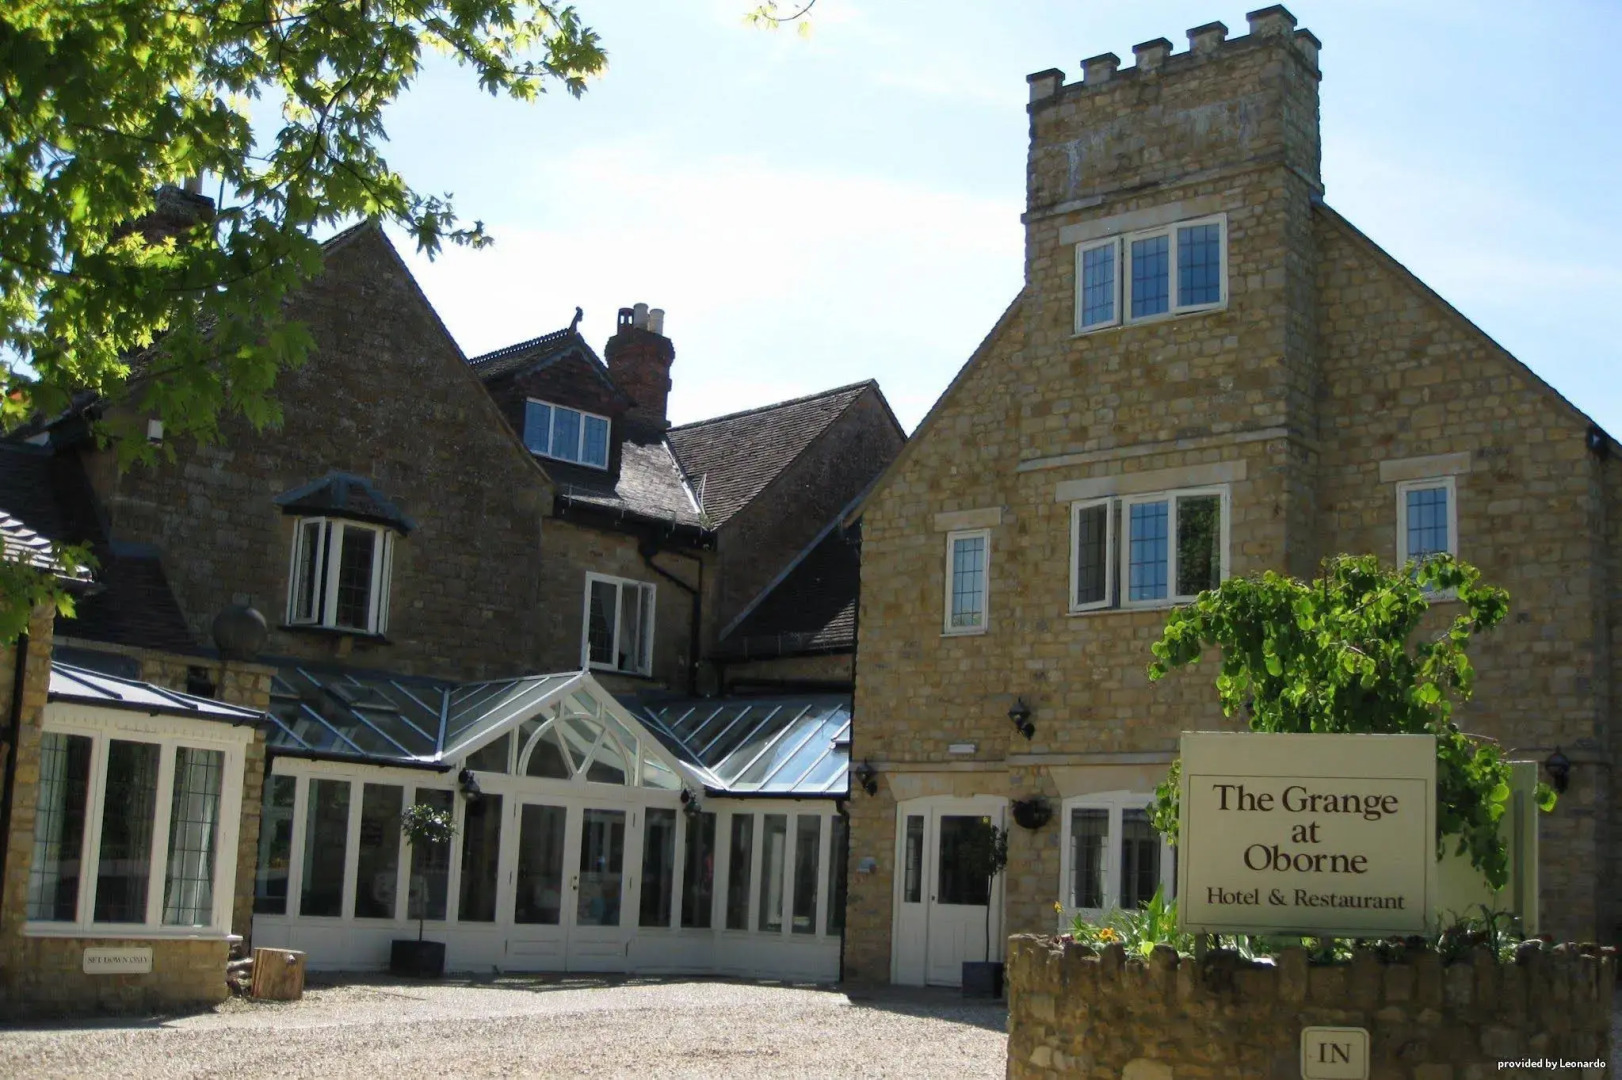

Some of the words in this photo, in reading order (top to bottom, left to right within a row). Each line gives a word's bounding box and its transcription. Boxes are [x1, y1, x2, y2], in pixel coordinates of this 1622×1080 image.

[1212, 784, 1274, 812] The
[1282, 785, 1399, 821] Grange
[1291, 821, 1321, 844] at
[1243, 843, 1368, 874] Oborne
[1206, 887, 1260, 905] Hotel
[1268, 888, 1288, 906] &
[1293, 888, 1406, 910] Restaurant
[1317, 1042, 1352, 1064] IN
